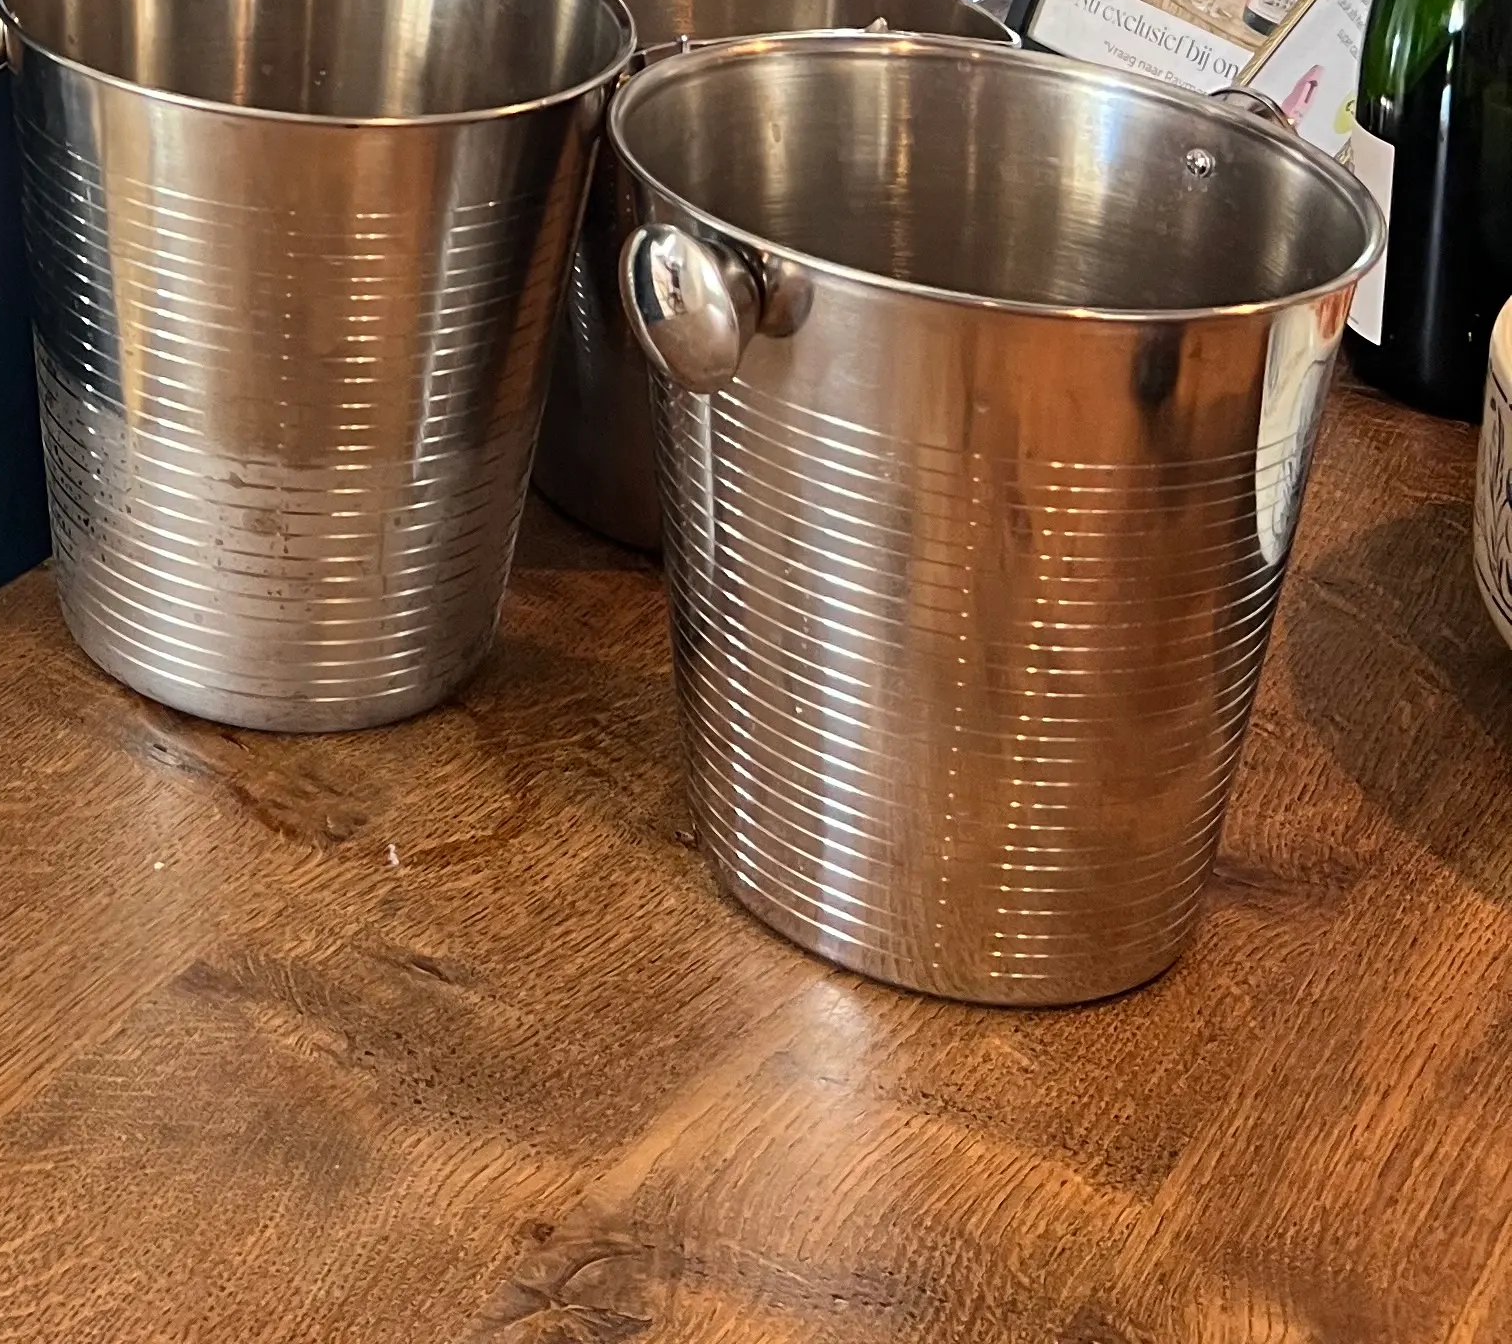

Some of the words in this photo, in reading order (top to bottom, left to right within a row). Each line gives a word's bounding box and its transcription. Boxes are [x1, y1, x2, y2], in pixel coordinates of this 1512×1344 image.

[1102, 4, 1189, 54] exclusief
[1186, 39, 1213, 72] bij
[1213, 57, 1240, 81] on
[1137, 59, 1163, 78] naar
